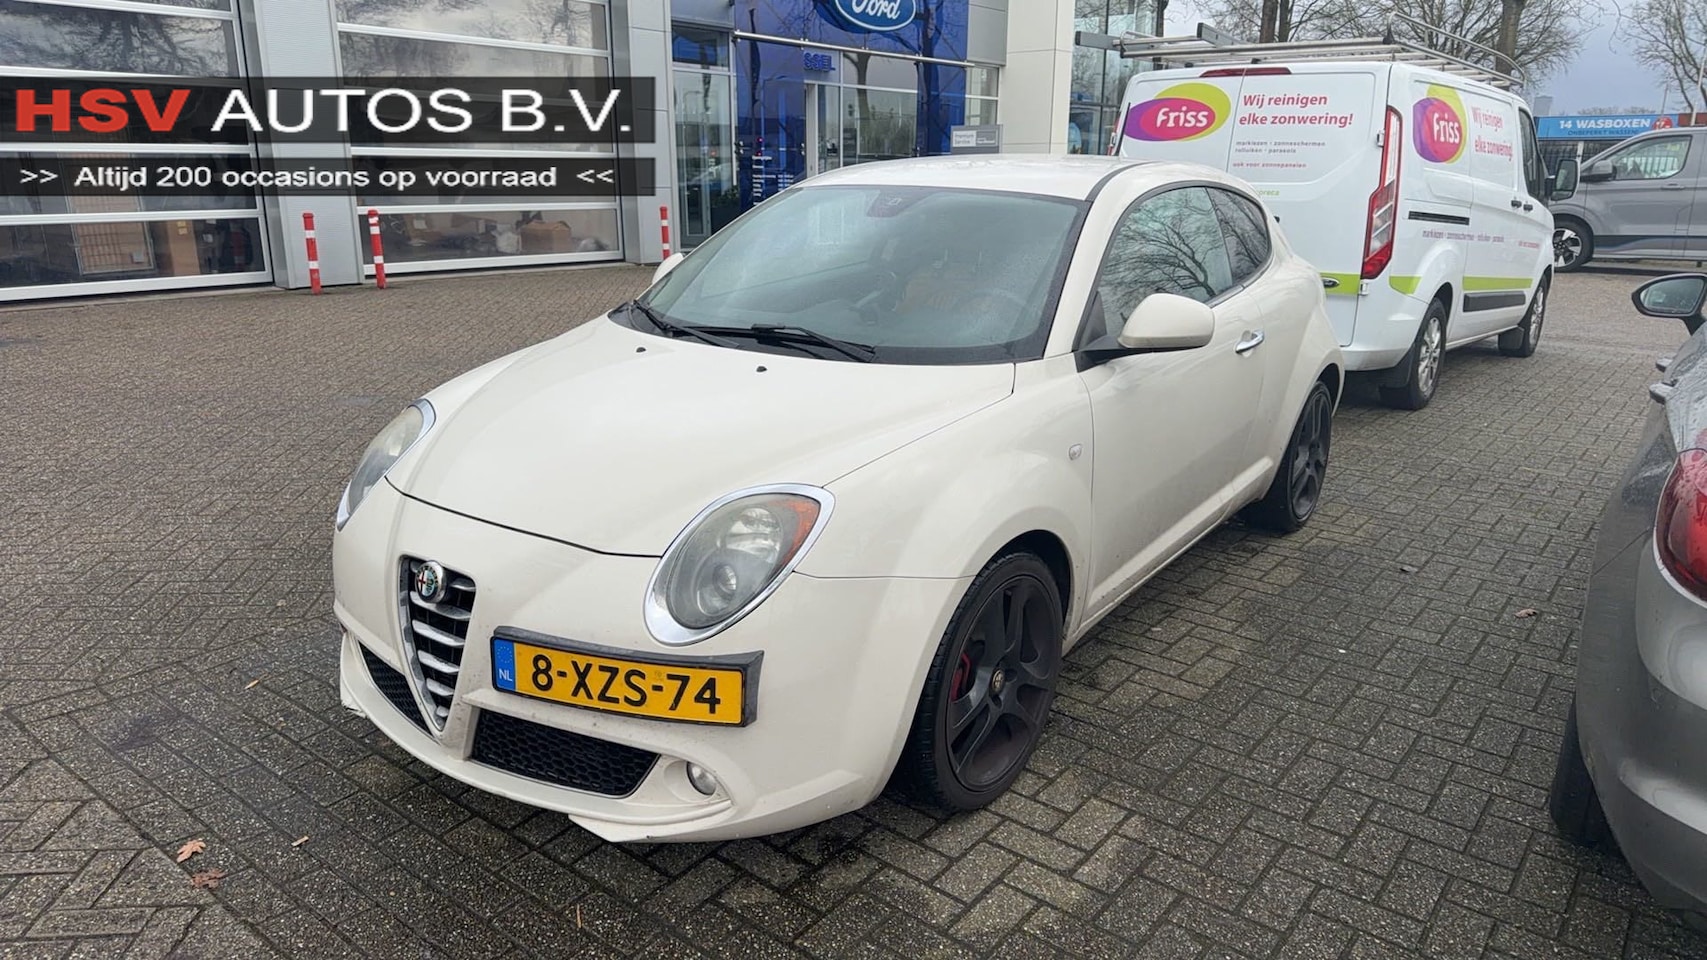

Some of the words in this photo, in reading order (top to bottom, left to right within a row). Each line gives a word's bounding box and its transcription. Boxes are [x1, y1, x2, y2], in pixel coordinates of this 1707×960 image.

[1243, 94, 1265, 109] Wij
[1267, 93, 1328, 109] reinigen
[1239, 112, 1268, 125] elke
[1270, 112, 1354, 129] zonwering!
[1559, 120, 1573, 129] 14
[1576, 118, 1651, 129] WASBOXEN
[1257, 189, 1280, 197] oreca
[498, 668, 513, 683] NL
[531, 654, 721, 715] 8-XZS-74
